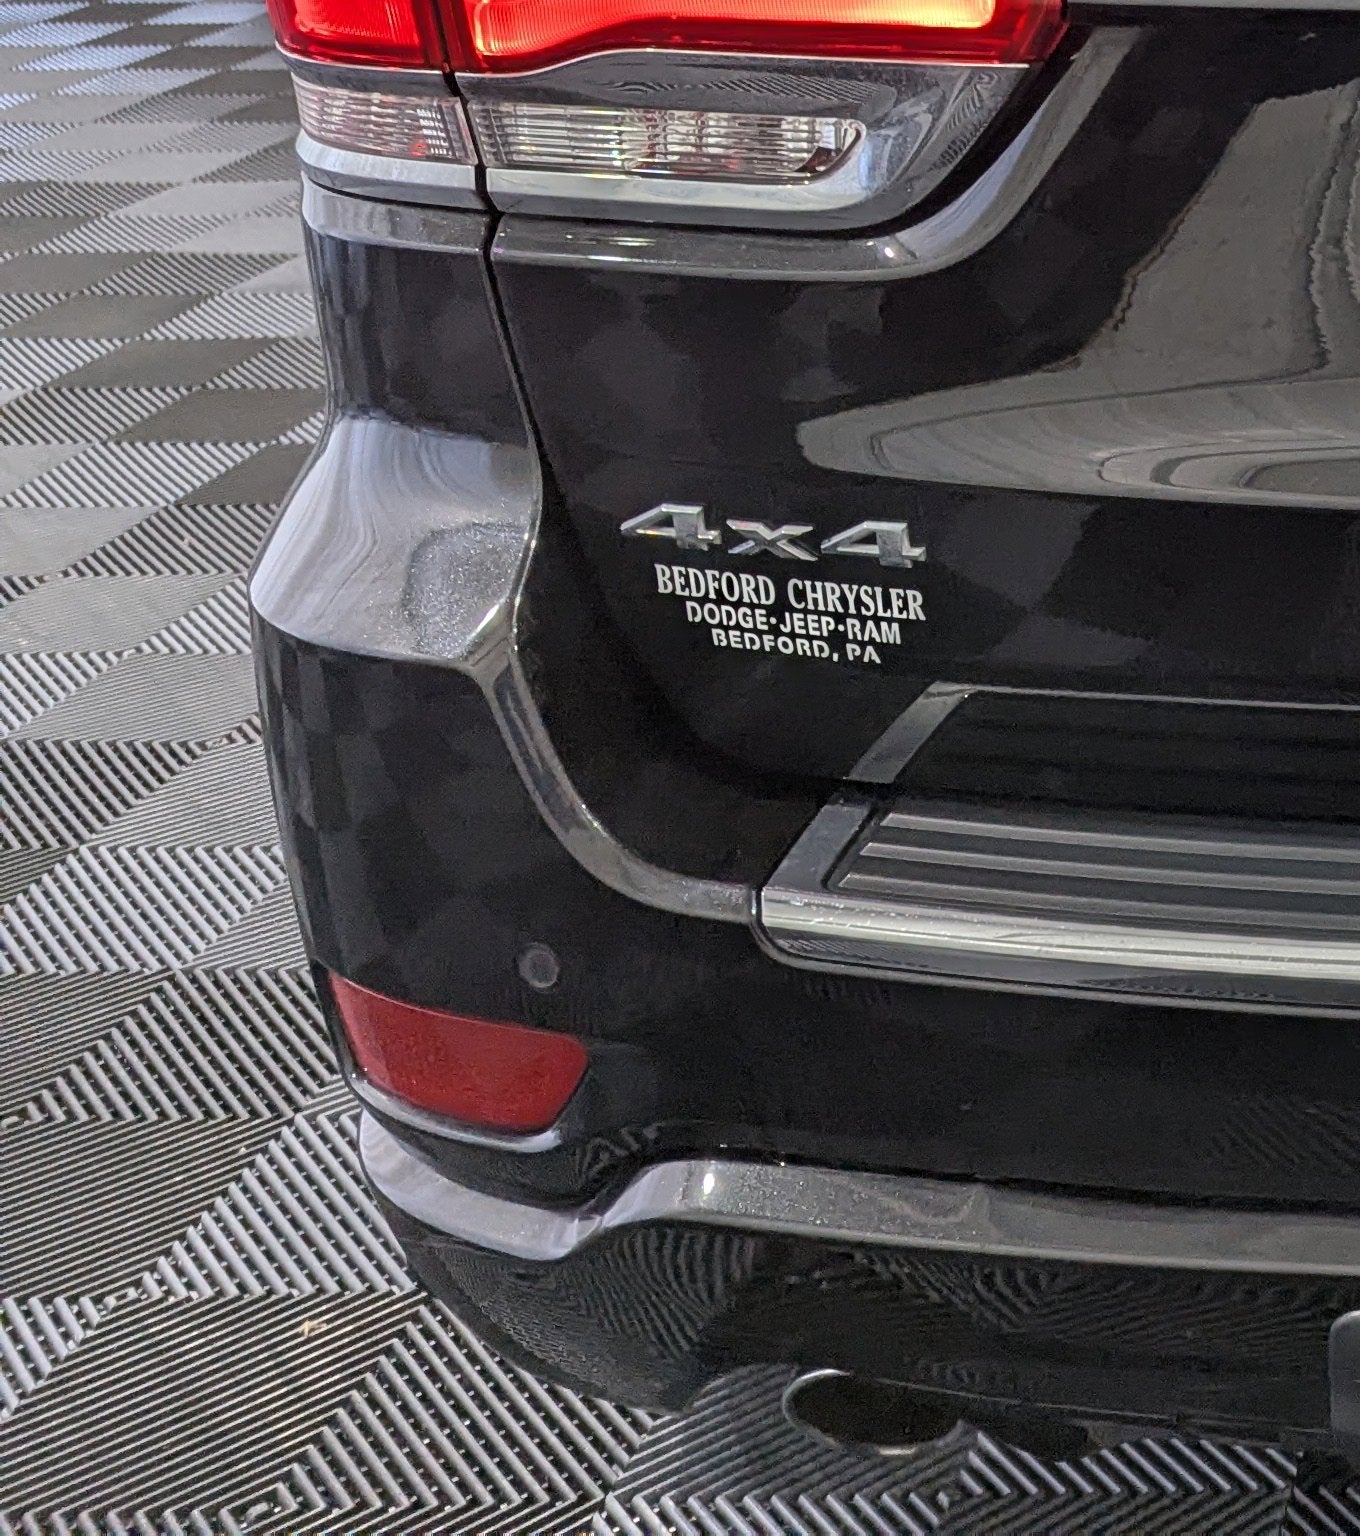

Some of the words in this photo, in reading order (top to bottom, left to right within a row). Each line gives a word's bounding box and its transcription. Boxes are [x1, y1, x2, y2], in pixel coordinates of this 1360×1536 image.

[654, 563, 776, 605] BEDFORD
[787, 578, 927, 621] CHRYSLER
[712, 628, 839, 662] BEDFORD,
[846, 642, 882, 664] PA
